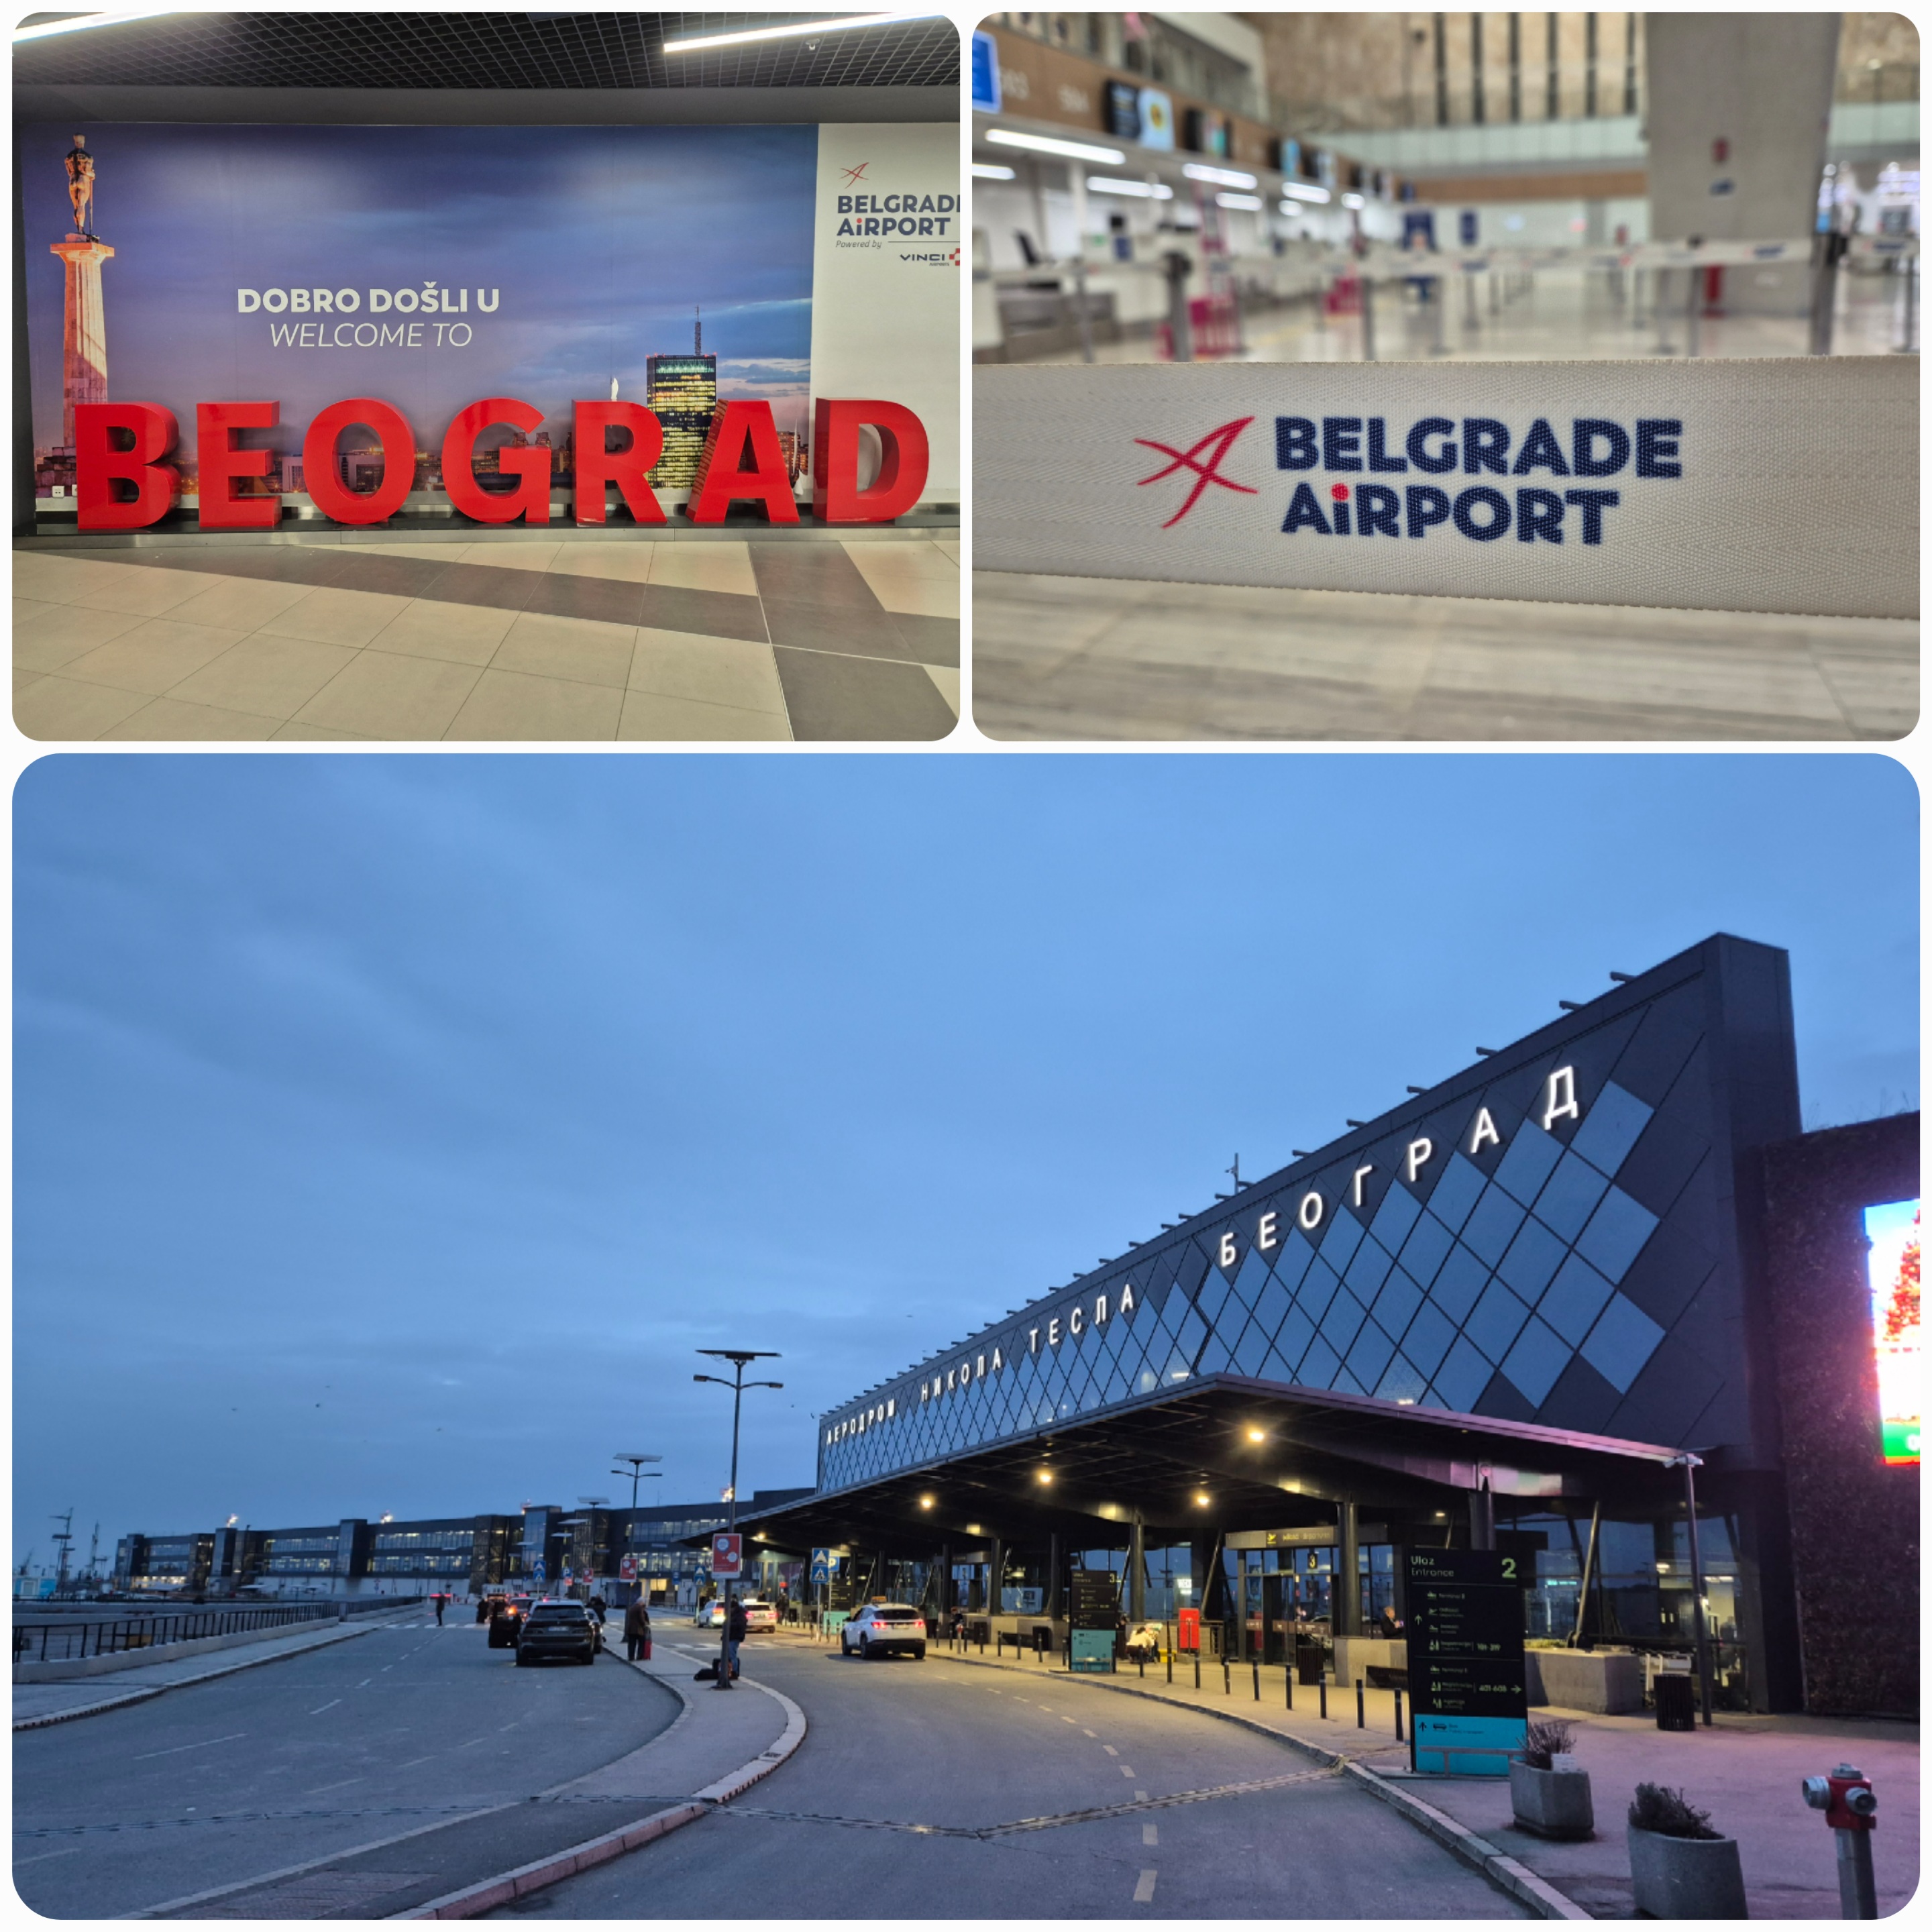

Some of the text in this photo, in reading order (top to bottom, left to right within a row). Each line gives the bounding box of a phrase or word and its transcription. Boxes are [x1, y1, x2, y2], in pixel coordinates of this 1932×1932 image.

[837, 194, 960, 214] BELGRAD
[836, 239, 882, 250] Powered by
[237, 281, 499, 313] DOBRO DOŠLI U
[270, 322, 472, 347] WELCOME TO
[1274, 415, 1684, 480] BELGRADE
[74, 396, 929, 529] BEOGRAD
[826, 1065, 1578, 1446] АЕРОДРОМ НИКОЛА ТЕСЛА БЕОГРАД
[1410, 1555, 1435, 1566] Ulaz
[1501, 1557, 1517, 1578] 2
[1109, 1572, 1115, 1583] 3
[1411, 1567, 1454, 1577] Entrance
